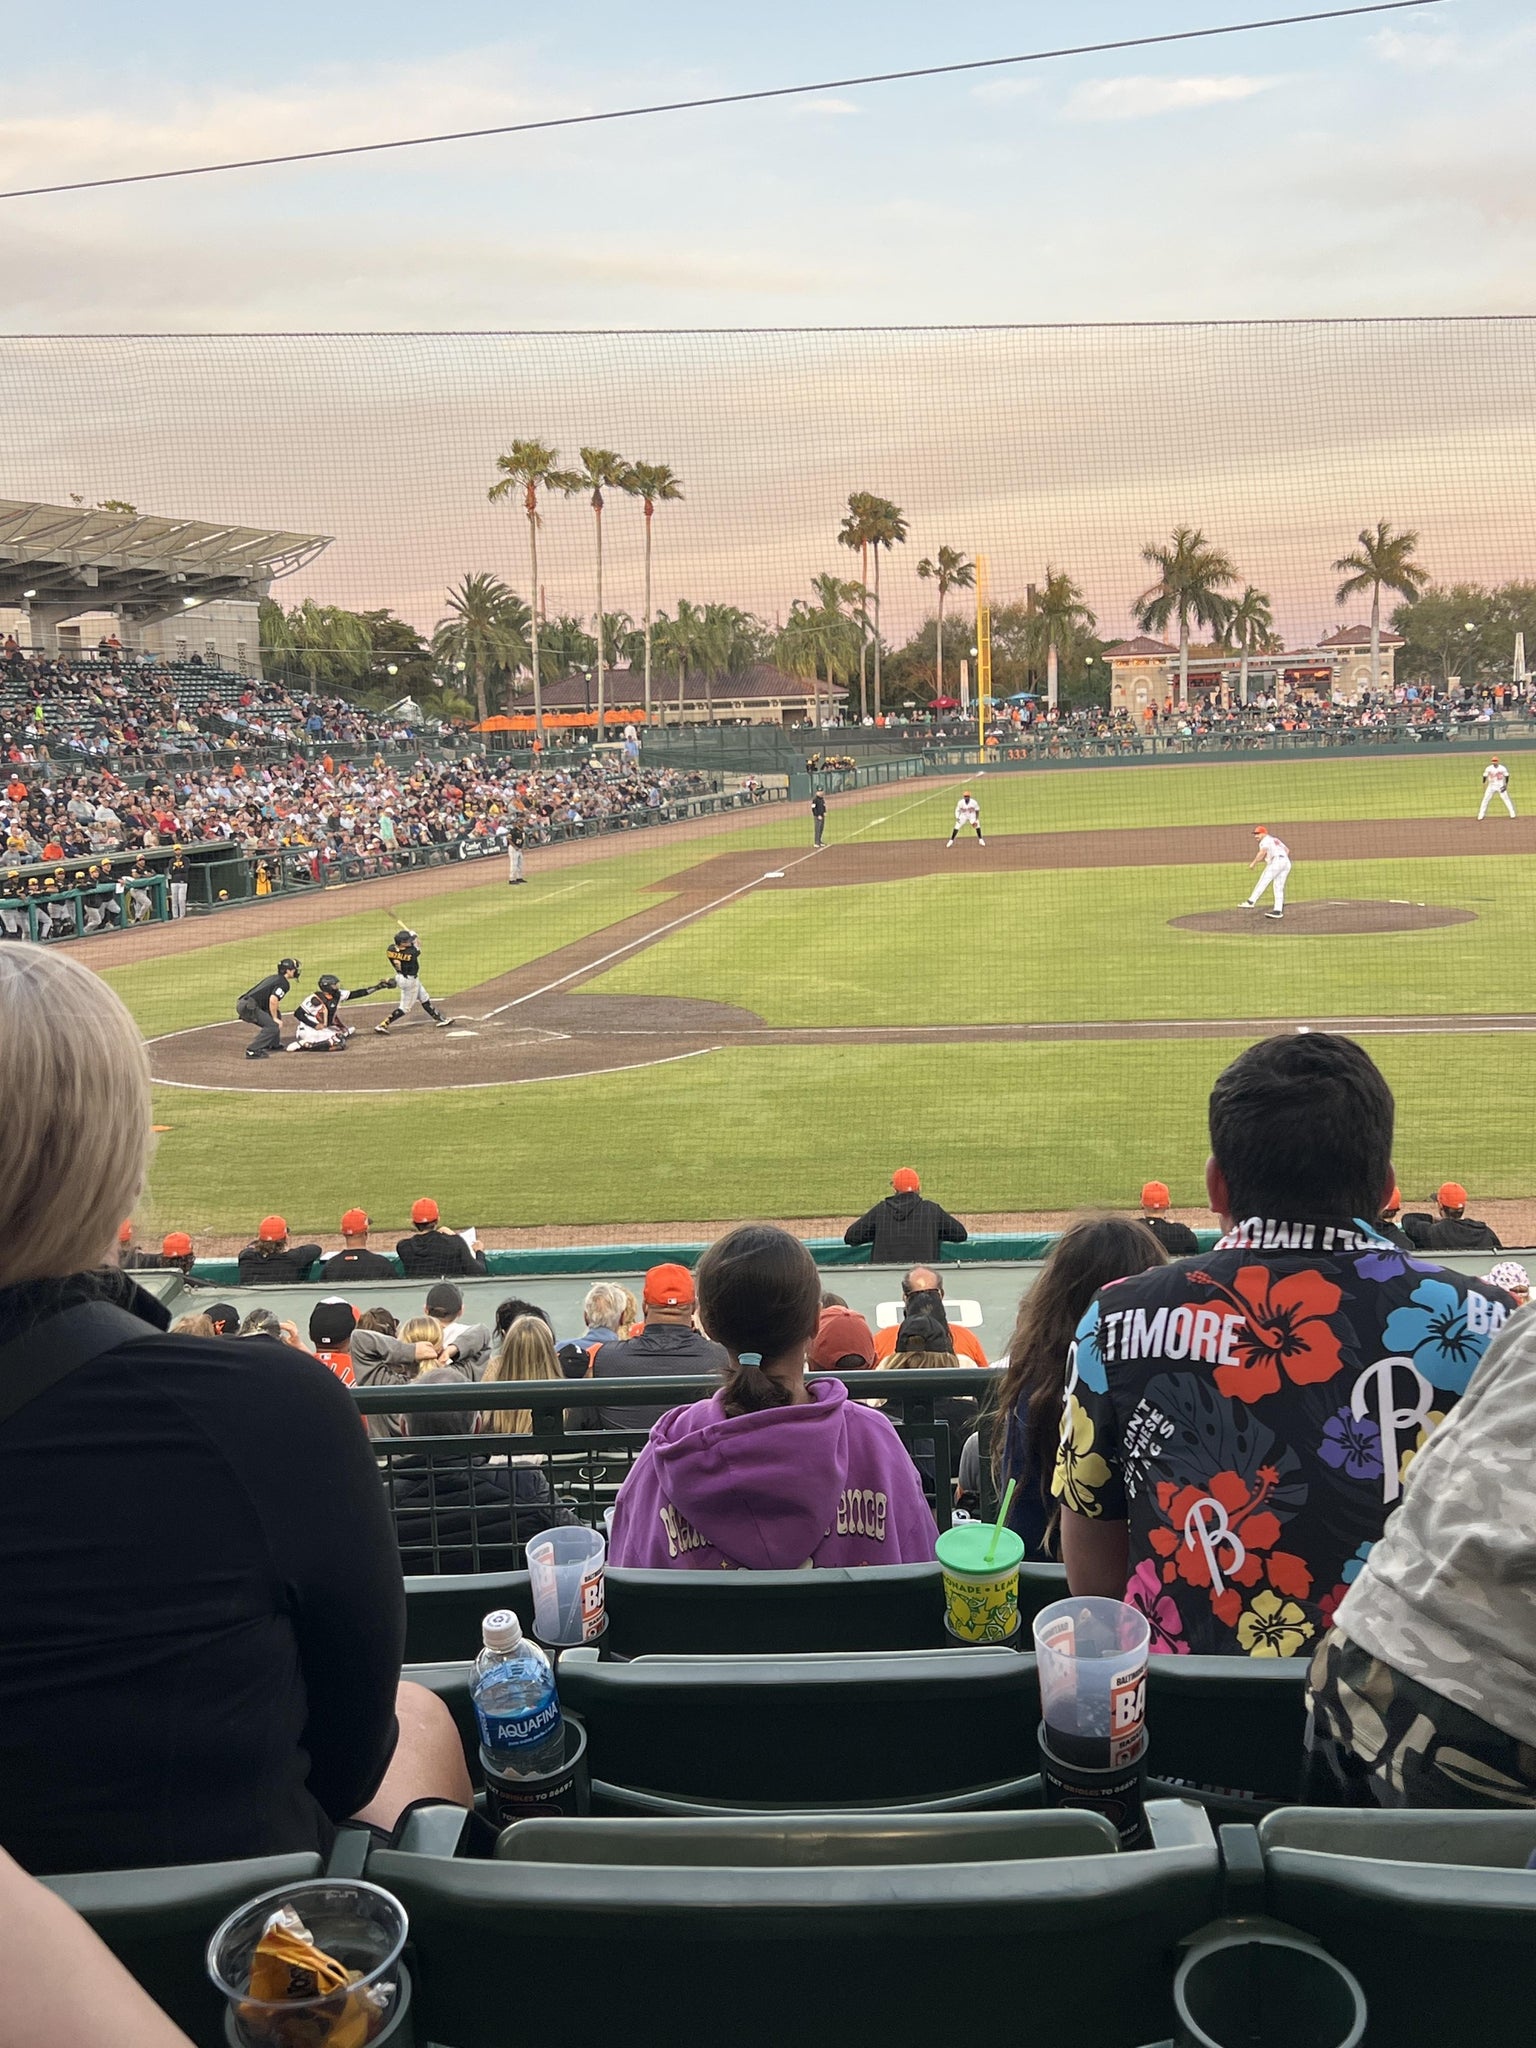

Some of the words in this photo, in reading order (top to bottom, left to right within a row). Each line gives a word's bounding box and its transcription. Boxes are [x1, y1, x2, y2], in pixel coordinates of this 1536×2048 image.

[1007, 748, 1028, 760] 333
[1102, 1306, 1246, 1367] TIMORE
[1467, 1289, 1508, 1339] BA
[1123, 1398, 1151, 1450] CAN'T
[824, 1488, 888, 1542] ence
[1184, 1497, 1246, 1597] B
[498, 1700, 559, 1739] AQUAFINA
[535, 1792, 547, 1801] TO
[1101, 1788, 1114, 1796] TO
